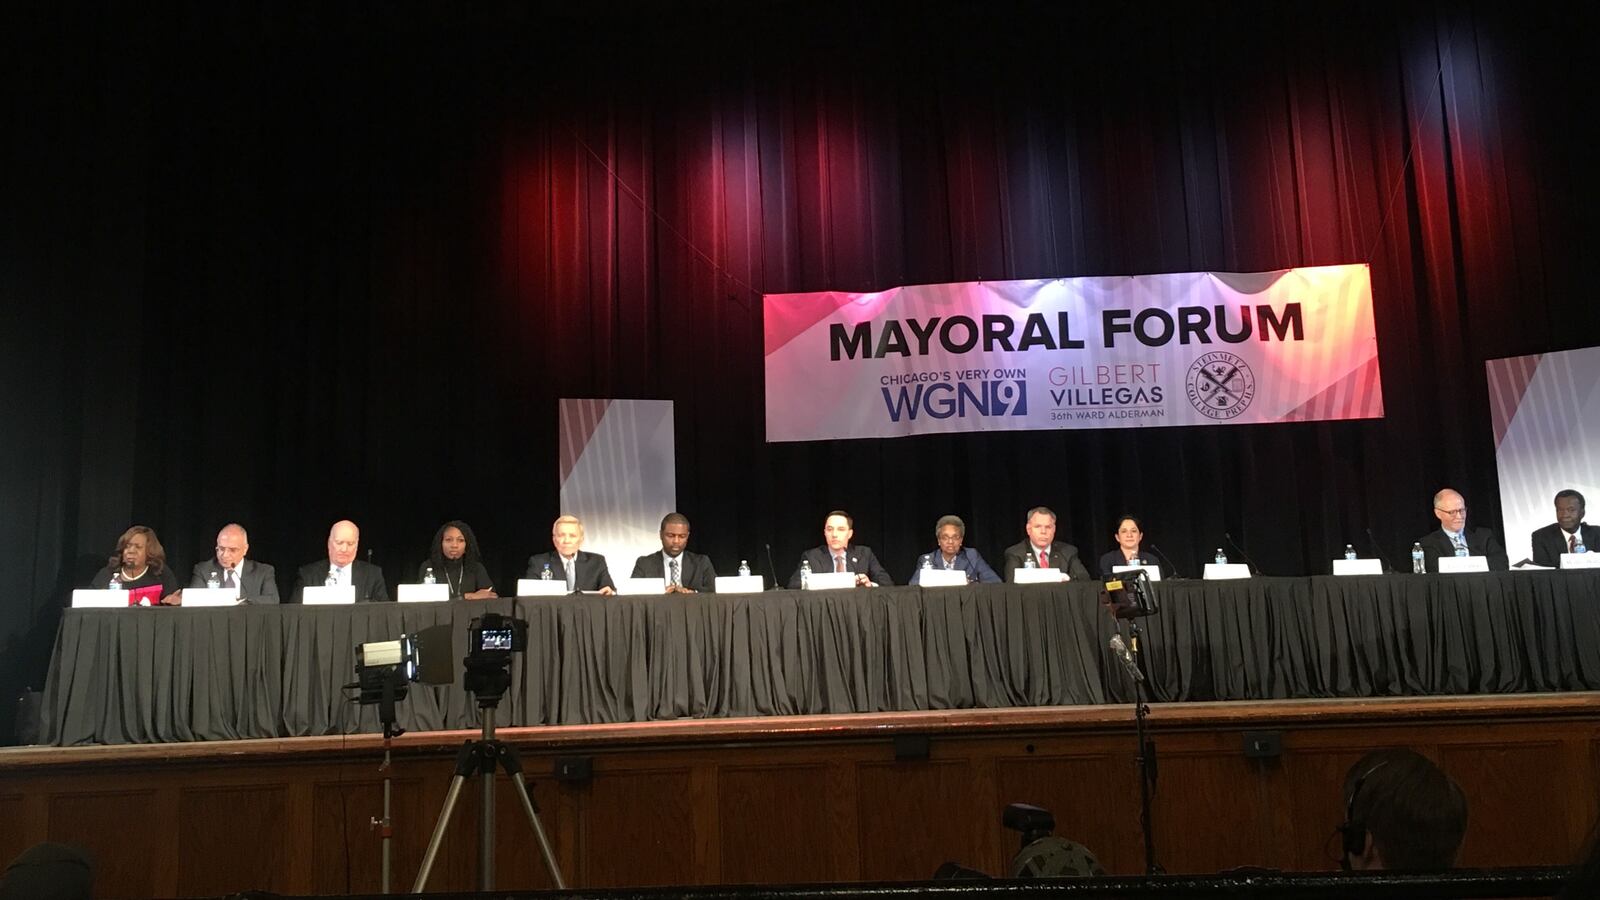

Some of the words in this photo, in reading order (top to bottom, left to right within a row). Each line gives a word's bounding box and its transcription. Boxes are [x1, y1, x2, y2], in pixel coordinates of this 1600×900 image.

[830, 312, 1084, 361] MAYORAL
[1102, 303, 1304, 348] FORUM
[1192, 353, 1246, 371] STEINMETZ
[880, 371, 951, 386] CHICAGO'S
[956, 369, 990, 380] VERY
[993, 368, 1026, 379] OWN
[1049, 364, 1160, 386] GILBERT
[1050, 386, 1163, 407] VILLEGAS
[1187, 382, 1218, 417] COLLEGE
[1051, 411, 1073, 421] 36th
[1076, 411, 1105, 420] WARD
[1108, 409, 1164, 419] ALDERMAN
